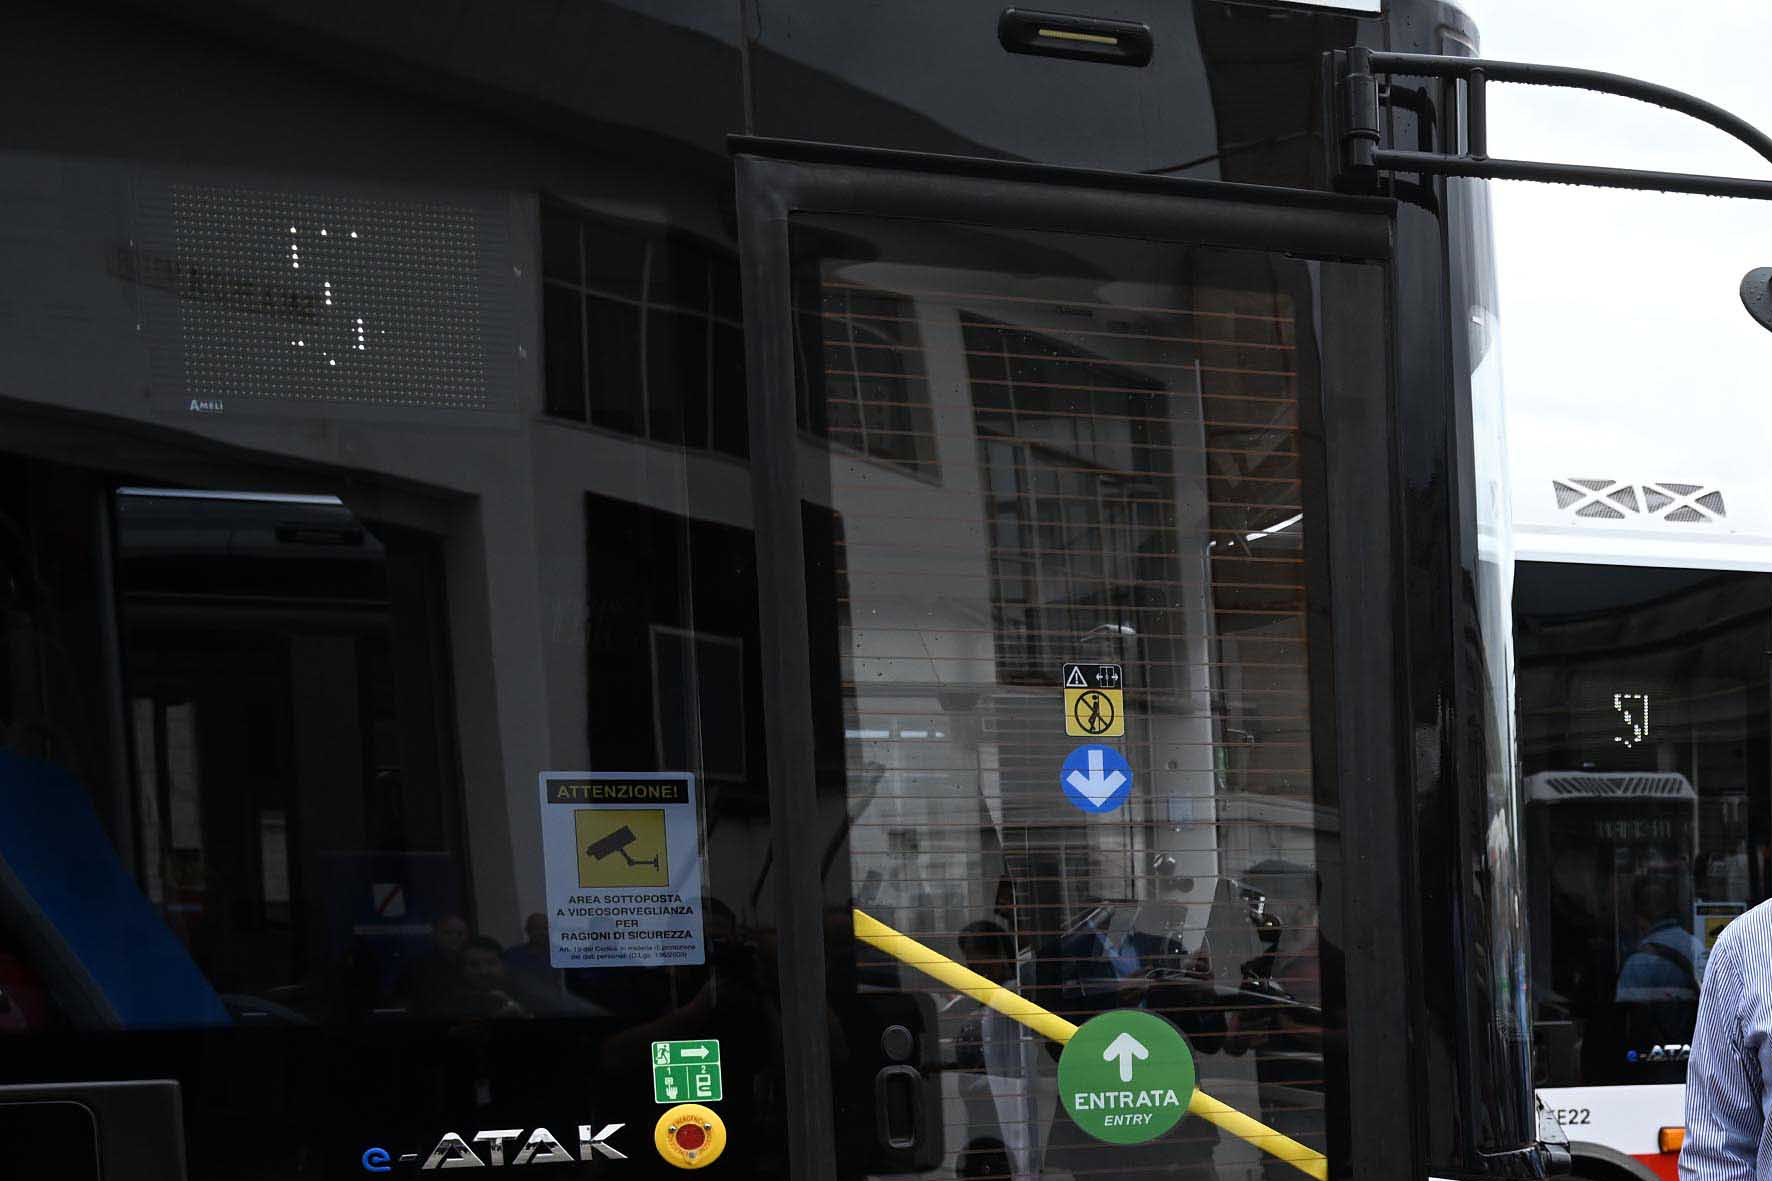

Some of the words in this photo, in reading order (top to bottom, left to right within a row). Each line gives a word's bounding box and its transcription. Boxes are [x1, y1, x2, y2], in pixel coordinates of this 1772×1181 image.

[557, 784, 679, 799] ATTENZIONE!
[568, 895, 601, 905] AREA
[603, 894, 682, 904] SOTTOPOSTA
[556, 908, 566, 917] A
[568, 906, 694, 917] VIDEOSORVEGLIANZA
[615, 919, 639, 928] PER
[561, 931, 611, 941] RAGIONI
[613, 930, 625, 940] DI
[628, 929, 693, 940] SICUREZZA
[1074, 1089, 1180, 1110] ENTRATA
[1104, 1113, 1153, 1126] ENTRY
[362, 1122, 629, 1173] e-ATAK
